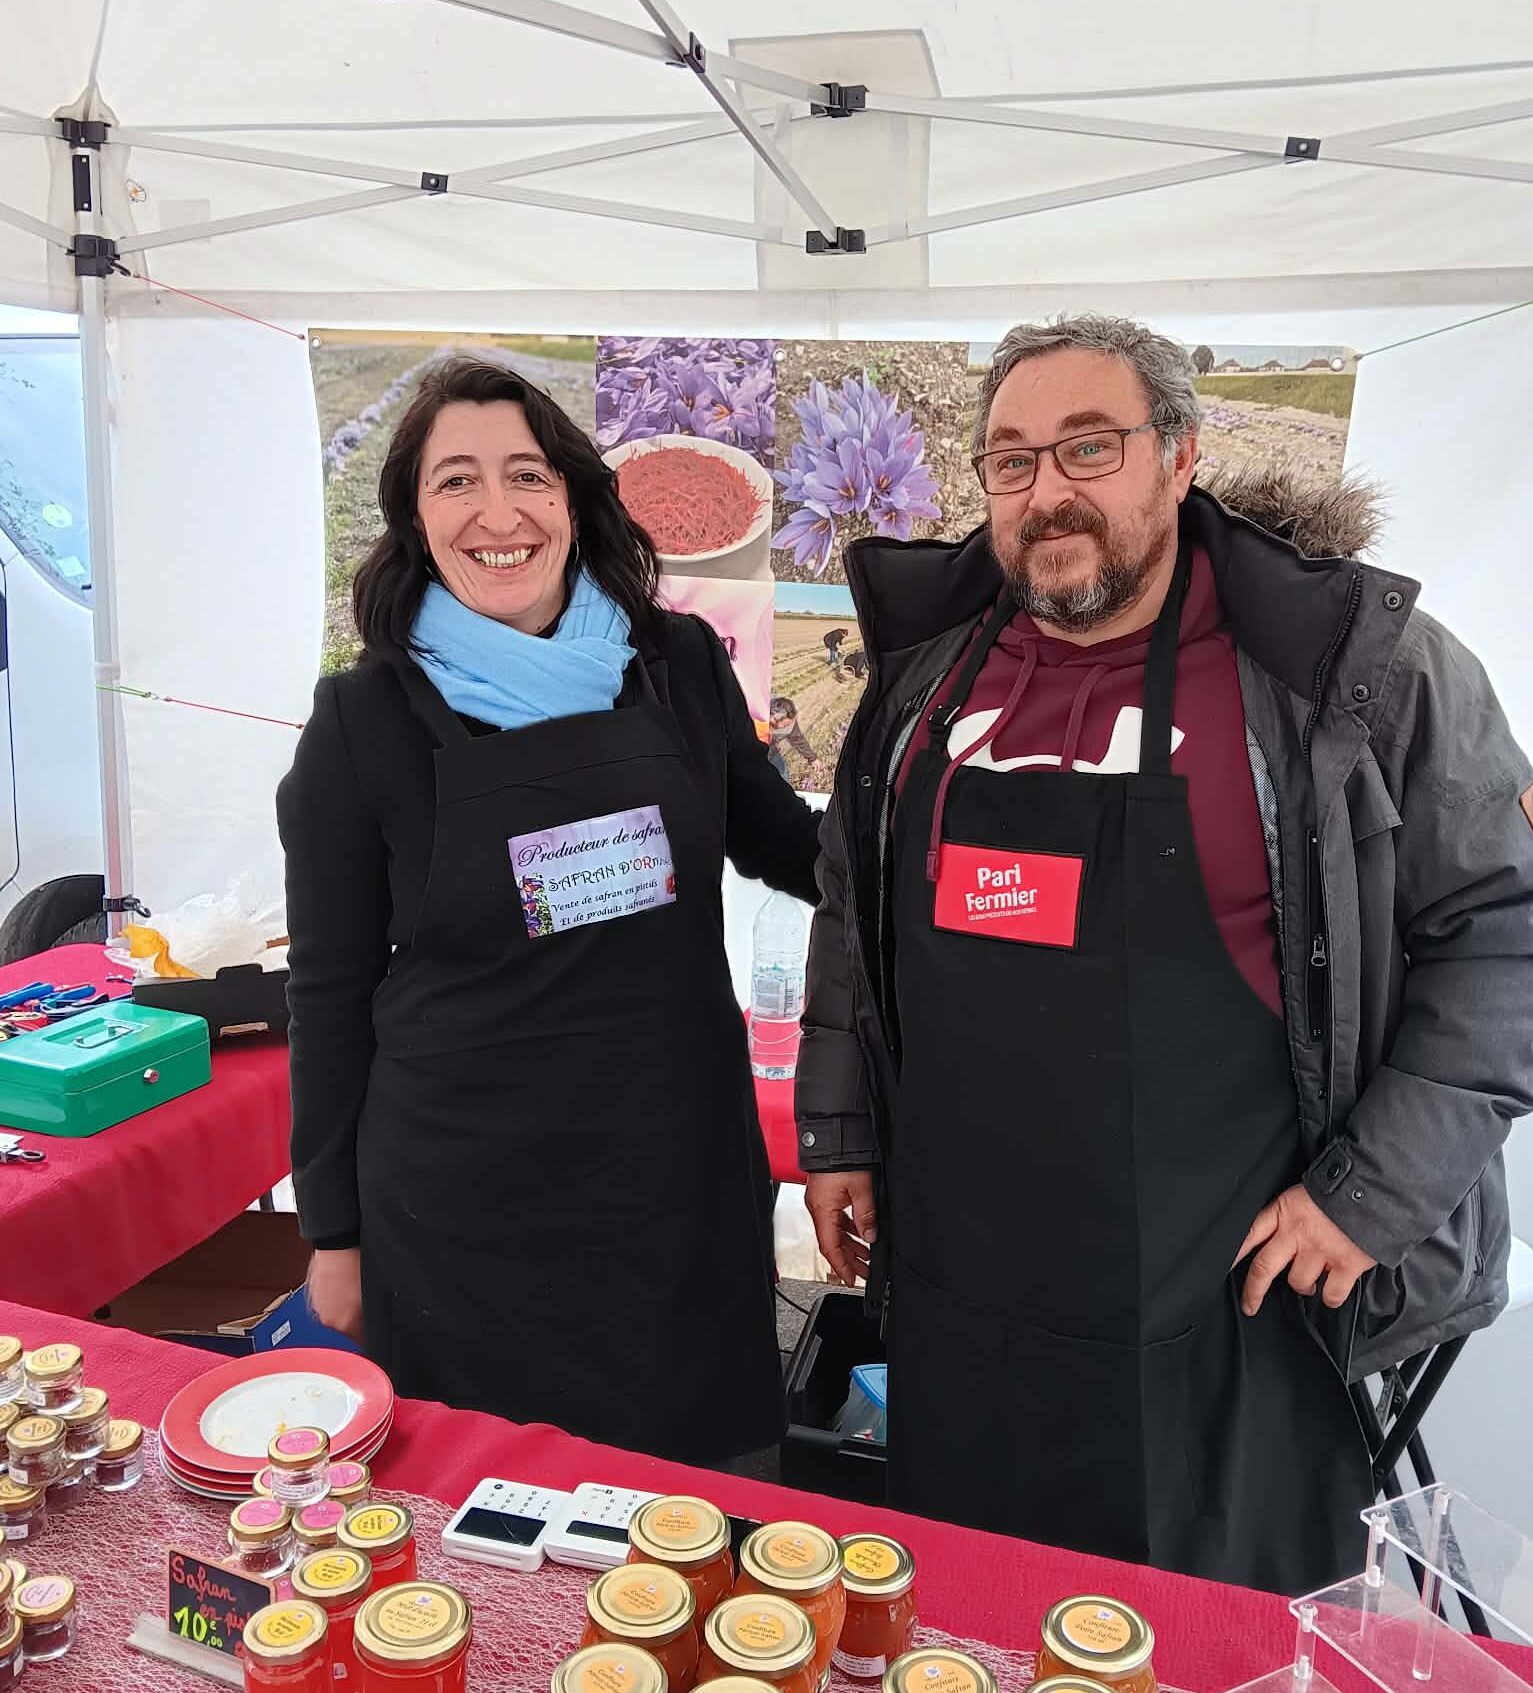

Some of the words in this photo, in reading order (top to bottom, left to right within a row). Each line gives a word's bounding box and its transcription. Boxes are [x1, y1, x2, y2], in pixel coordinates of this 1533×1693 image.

[518, 837, 609, 867] Producteur
[612, 828, 629, 845] de
[549, 864, 615, 891] SAFRAN
[977, 863, 1021, 890] Pari
[552, 900, 579, 913] Vente
[581, 895, 593, 905] de
[594, 890, 623, 903] safran
[625, 887, 635, 895] en
[634, 879, 658, 895] pistils
[965, 887, 1038, 912] Fermier
[560, 917, 571, 926] Et
[573, 912, 584, 923] de
[586, 905, 622, 921] produits
[171, 1555, 236, 1602] Safran
[199, 1604, 223, 1621] en
